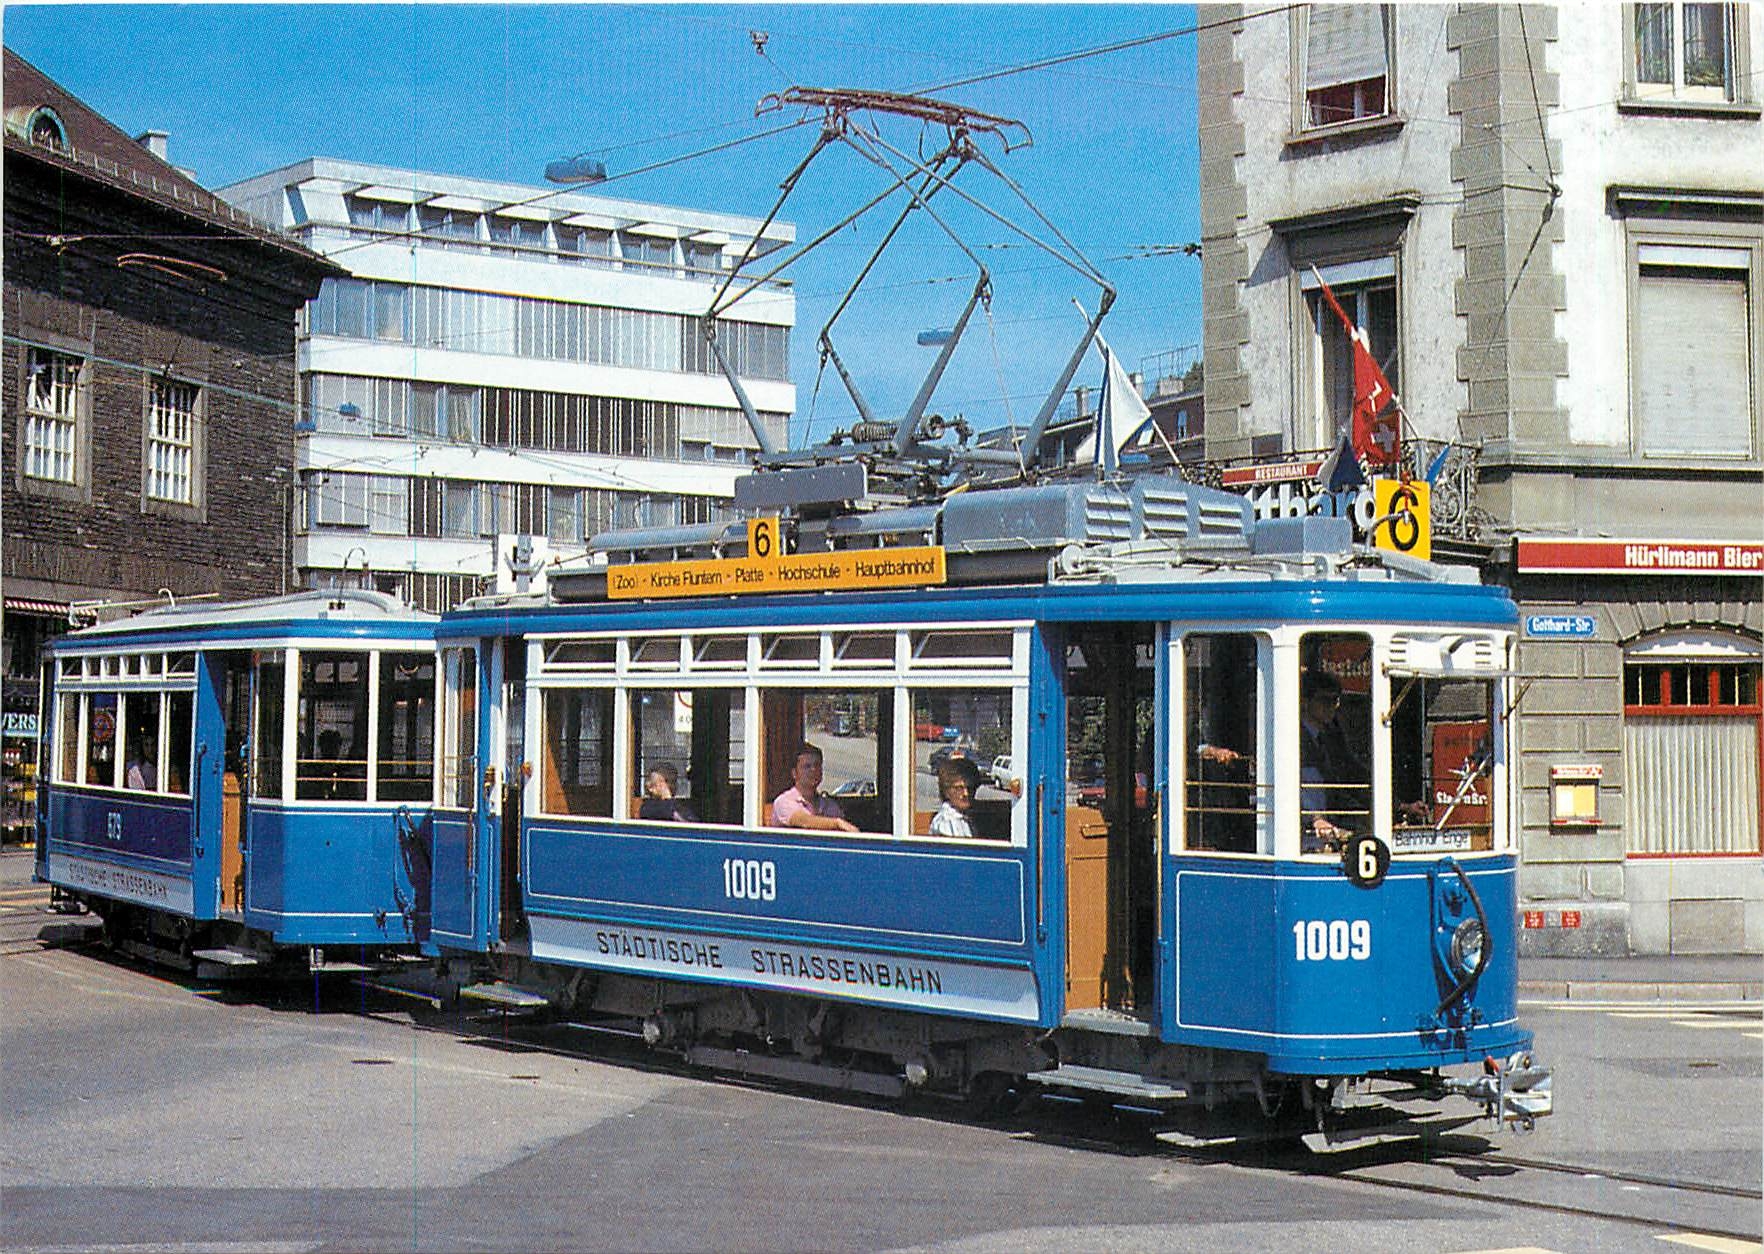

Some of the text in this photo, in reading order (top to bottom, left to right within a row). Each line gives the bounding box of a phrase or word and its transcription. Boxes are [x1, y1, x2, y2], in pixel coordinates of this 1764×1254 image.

[1255, 465, 1307, 479] RESTAURANT
[754, 521, 771, 557] 6
[1388, 487, 1420, 551] 6
[650, 573, 680, 587] Kirche
[683, 570, 722, 586] Fluntern
[735, 567, 764, 583] Platte
[778, 563, 840, 580] Hochschule
[856, 557, 935, 579] Hauptbahnhof
[1625, 545, 1763, 568] Hürlimann Bier
[723, 857, 777, 901] 1009
[1357, 839, 1377, 879] 6
[1292, 919, 1371, 961] 1009
[597, 931, 943, 995] STÄDTISCHE STRASSENBAHN
